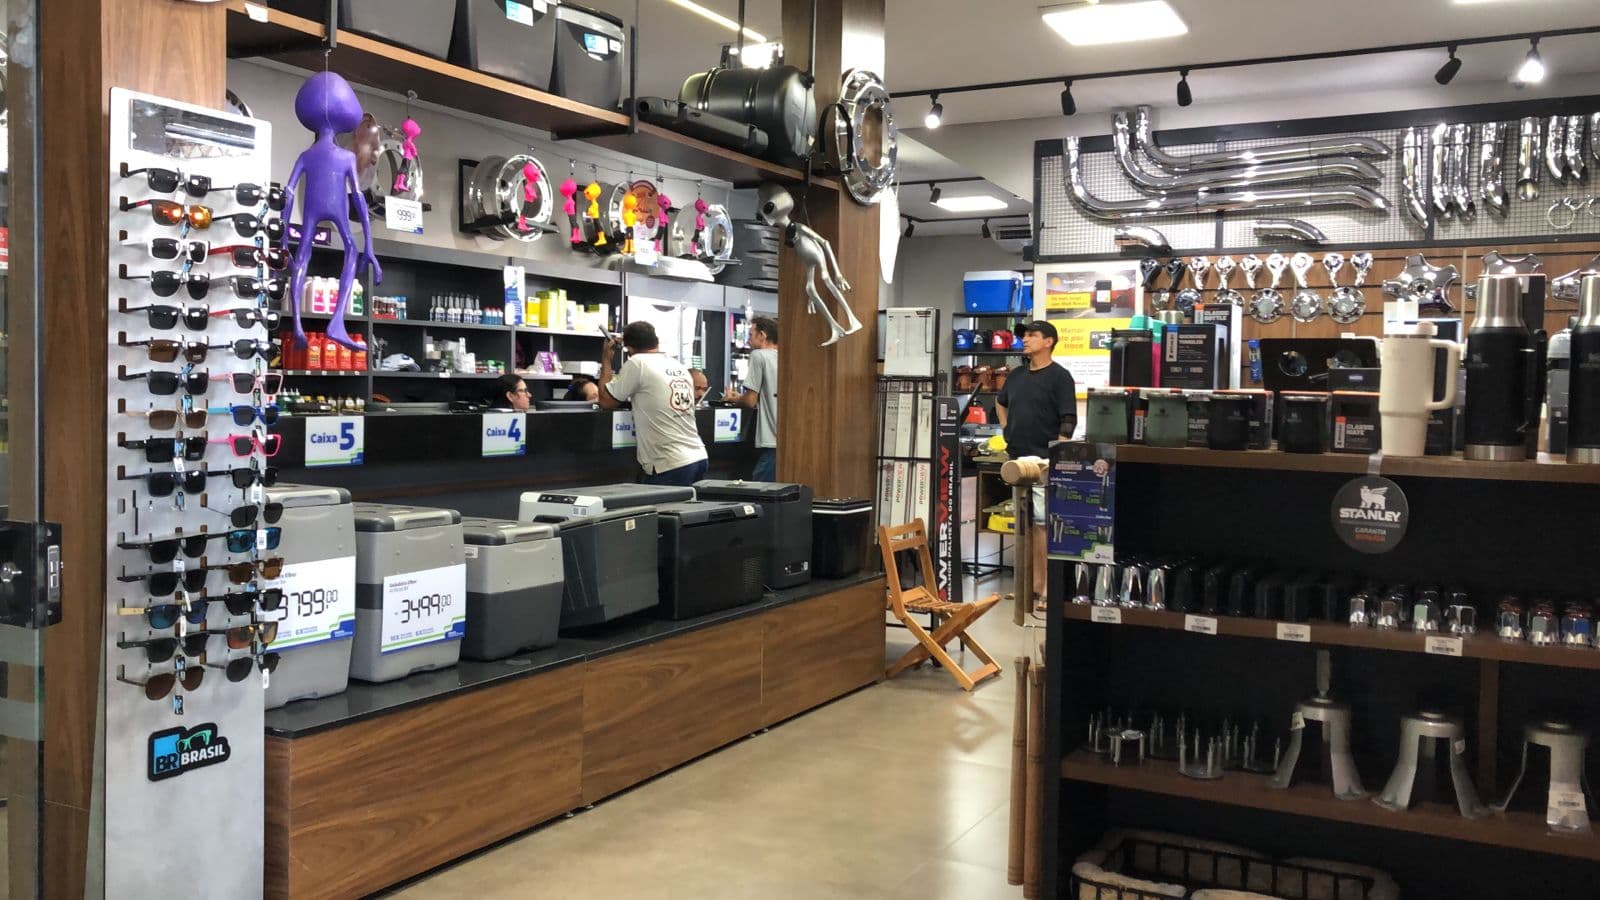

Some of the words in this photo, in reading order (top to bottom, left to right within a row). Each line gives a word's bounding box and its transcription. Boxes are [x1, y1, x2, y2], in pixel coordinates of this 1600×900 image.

[487, 427, 506, 437] Caixa
[508, 418, 521, 442] 4
[615, 420, 631, 431] Caixa
[730, 412, 738, 432] 2
[311, 432, 338, 444] Caixa
[340, 422, 355, 450] 5
[1339, 508, 1401, 522] STANLEY
[401, 594, 452, 624] 3499,00
[156, 752, 178, 772] BR
[181, 744, 225, 765] BRASIL
